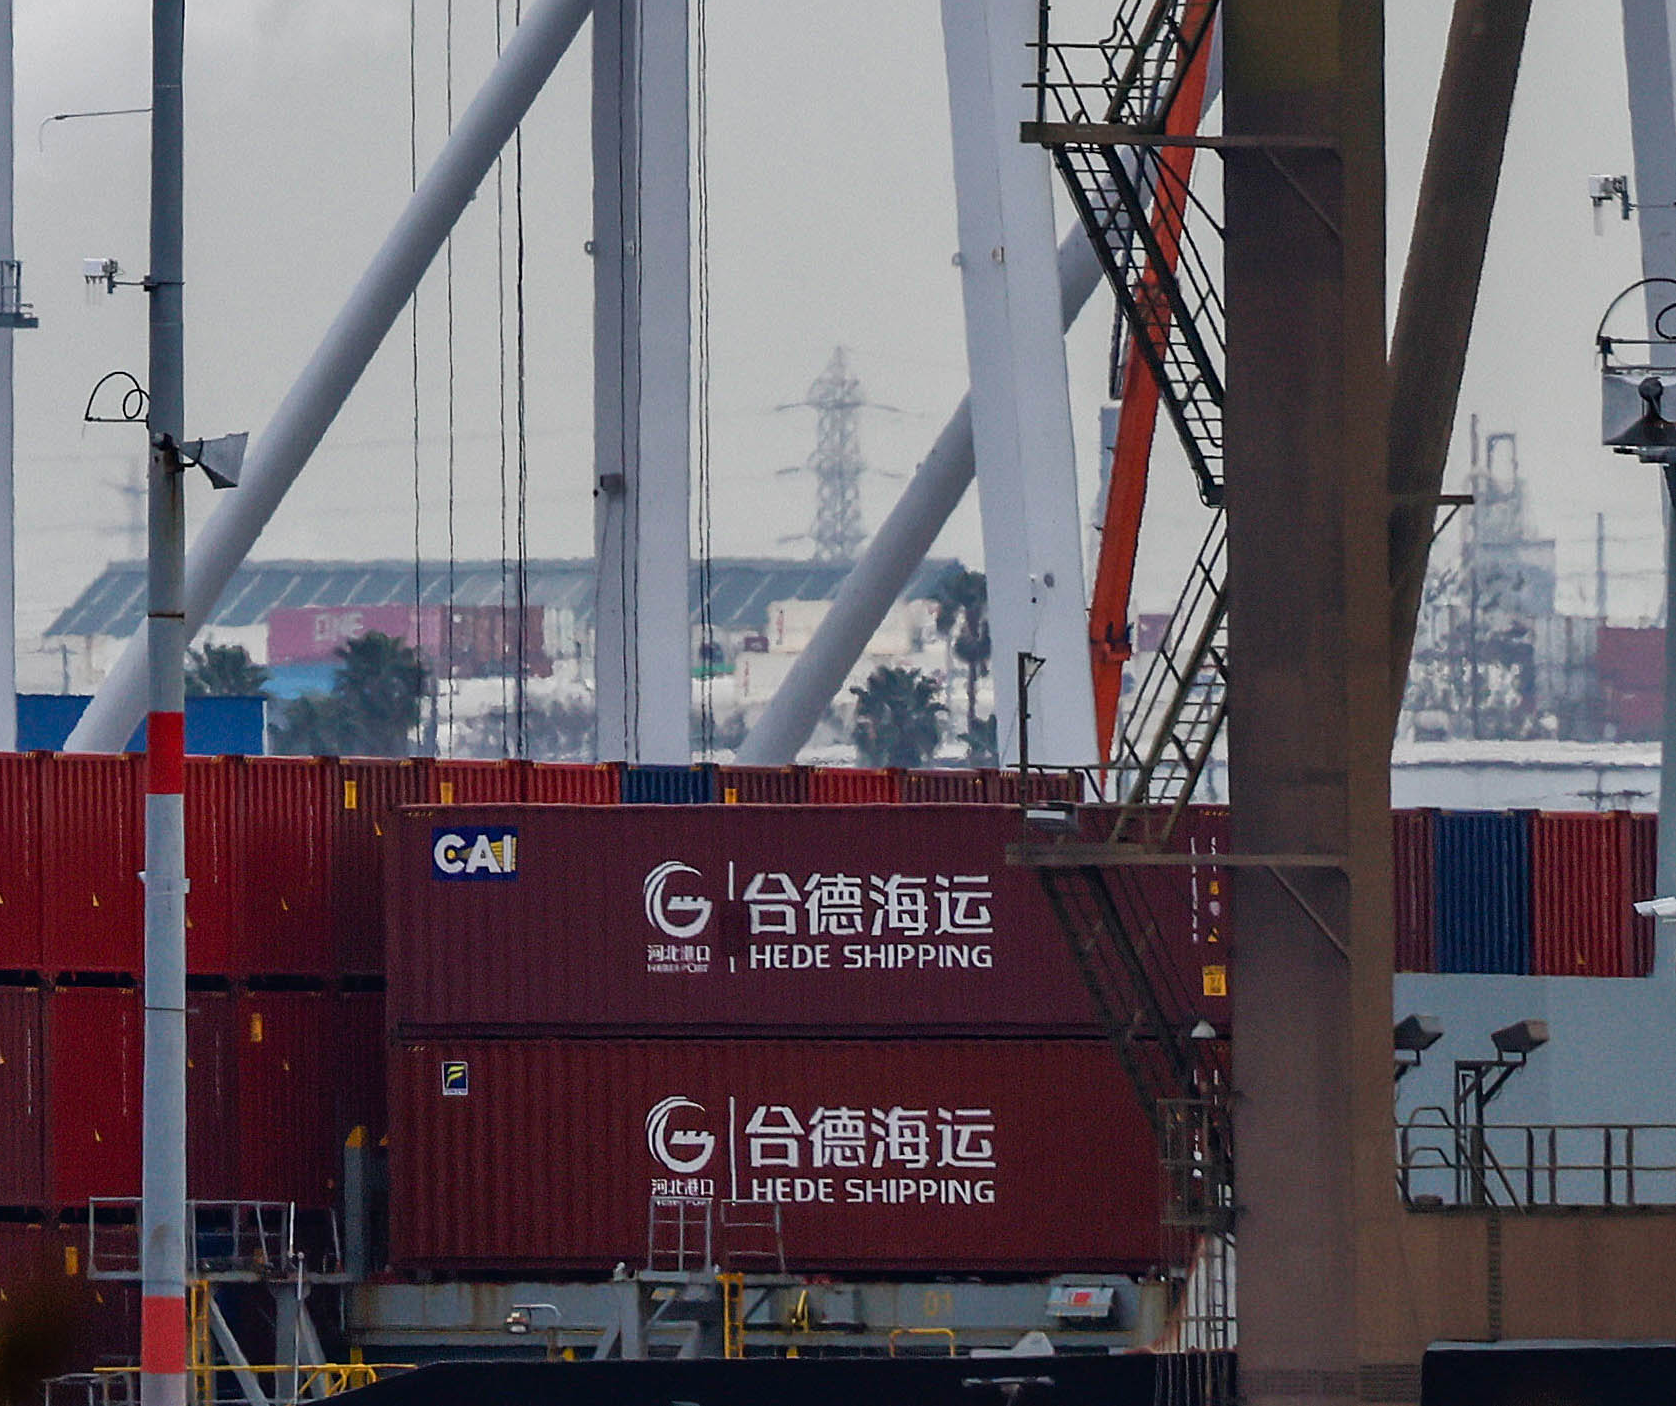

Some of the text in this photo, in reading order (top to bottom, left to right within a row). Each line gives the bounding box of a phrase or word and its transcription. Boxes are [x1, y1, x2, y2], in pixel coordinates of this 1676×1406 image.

[434, 833, 512, 874] CAI
[743, 873, 993, 936] 台德海运
[750, 944, 993, 969] HEDE SHIPPING
[745, 1106, 996, 1168] 台德海运
[752, 1178, 995, 1204] HEDE SHIPPING
